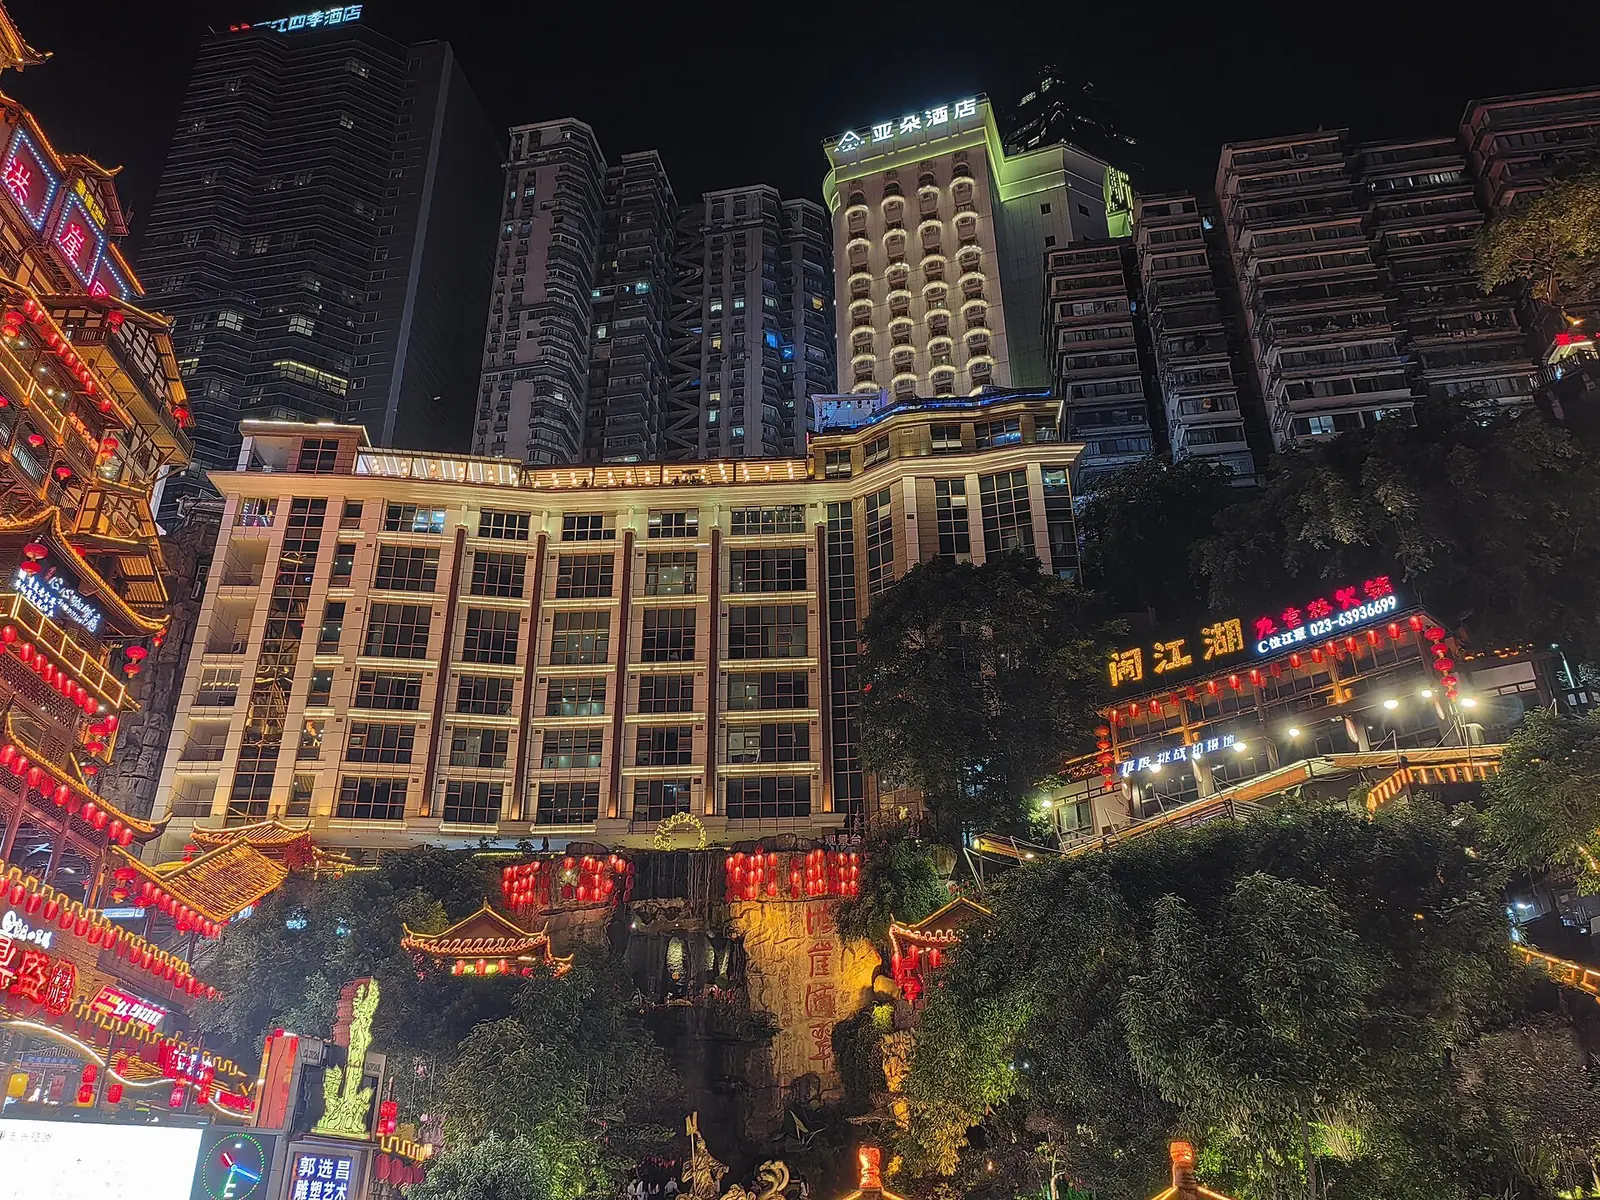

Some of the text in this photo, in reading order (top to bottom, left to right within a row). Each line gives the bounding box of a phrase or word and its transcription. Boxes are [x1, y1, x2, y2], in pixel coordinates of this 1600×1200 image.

[252, 4, 363, 33] 江四季酒店
[871, 98, 977, 143] 亚朵酒店
[1254, 575, 1393, 640] 九宫格火锅
[1310, 595, 1397, 637] 023-63936699
[1107, 617, 1245, 688] 闹江湖
[293, 1179, 348, 1200] 雕塑艺术
[298, 1156, 351, 1181] 郭选昌
